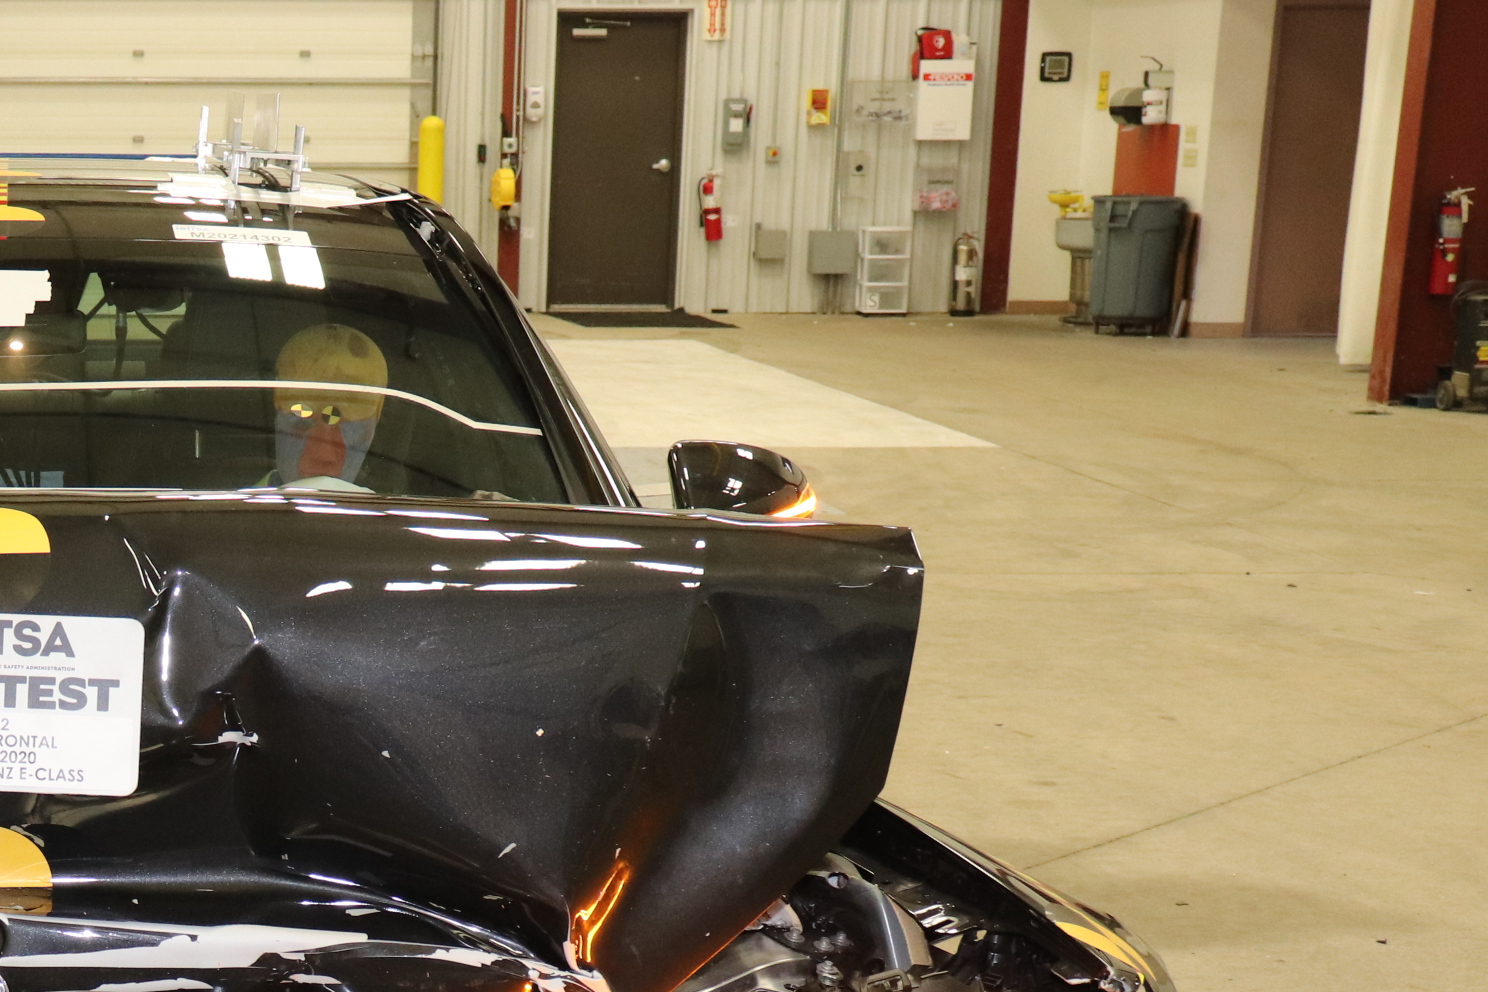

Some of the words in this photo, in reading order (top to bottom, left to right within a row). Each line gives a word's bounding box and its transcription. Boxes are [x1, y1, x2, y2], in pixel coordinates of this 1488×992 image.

[190, 231, 292, 243] M20214302
[0, 750, 37, 764] 2020
[19, 767, 85, 782] E-CLASS
